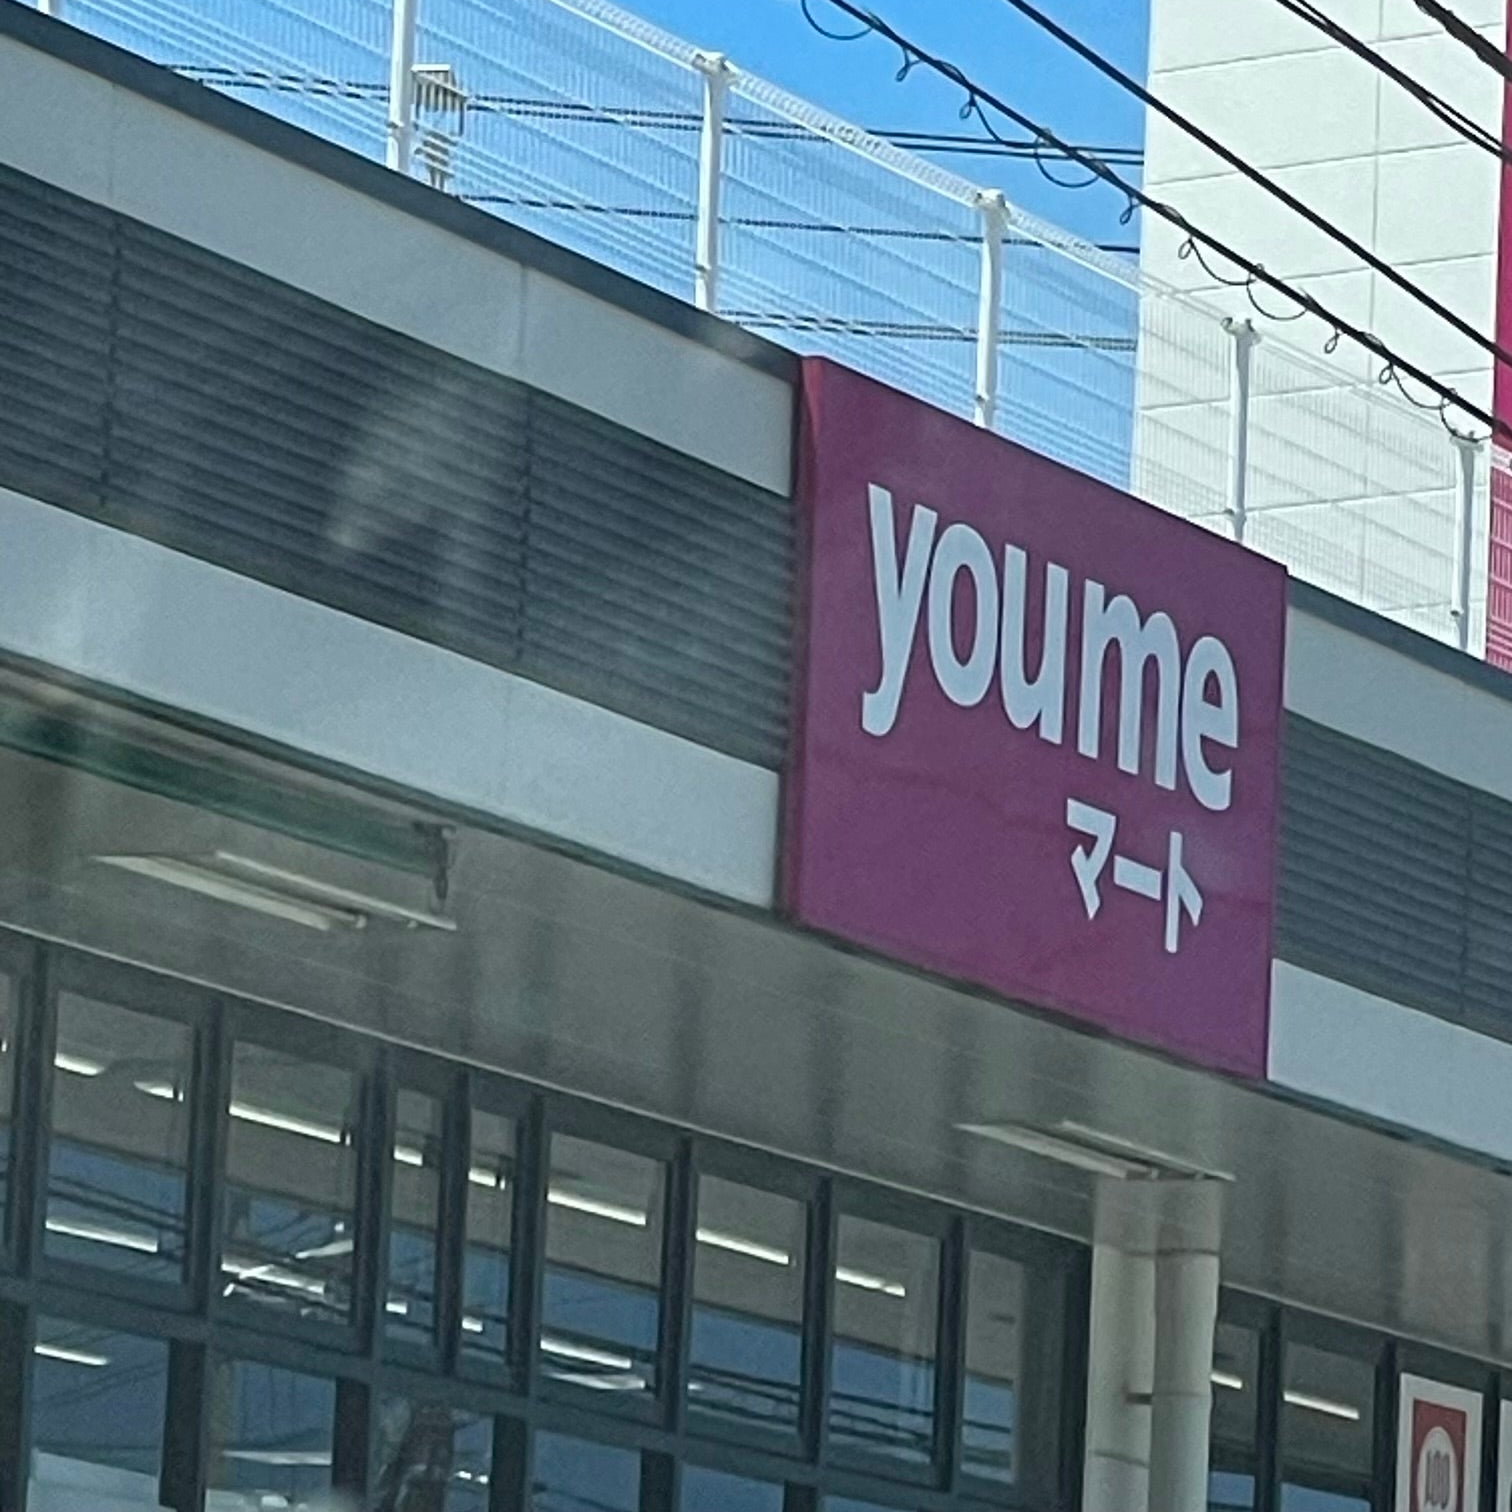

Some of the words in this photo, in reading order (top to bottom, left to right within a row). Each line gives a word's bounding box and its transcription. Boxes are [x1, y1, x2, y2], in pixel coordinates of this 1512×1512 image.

[861, 482, 1239, 811] youme
[1066, 797, 1203, 954] マート
